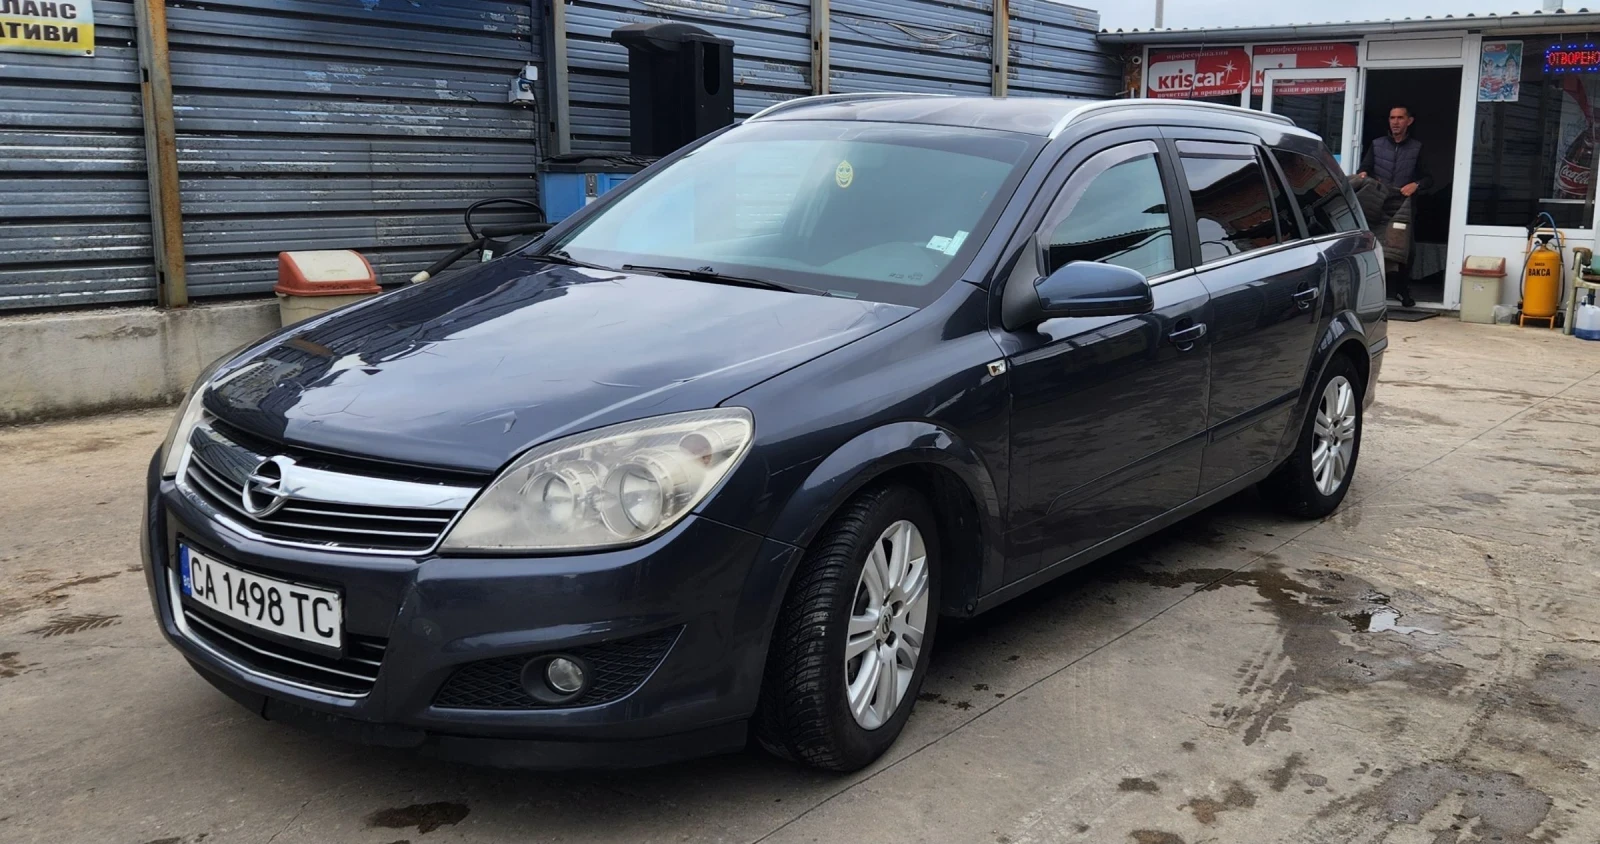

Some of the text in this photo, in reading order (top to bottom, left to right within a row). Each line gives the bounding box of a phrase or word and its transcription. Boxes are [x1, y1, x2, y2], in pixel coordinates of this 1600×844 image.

[0, 0, 77, 19] ЛАНС
[1548, 51, 1600, 66] ОТВОРЕНО
[191, 556, 334, 639] CA 1498 TC
